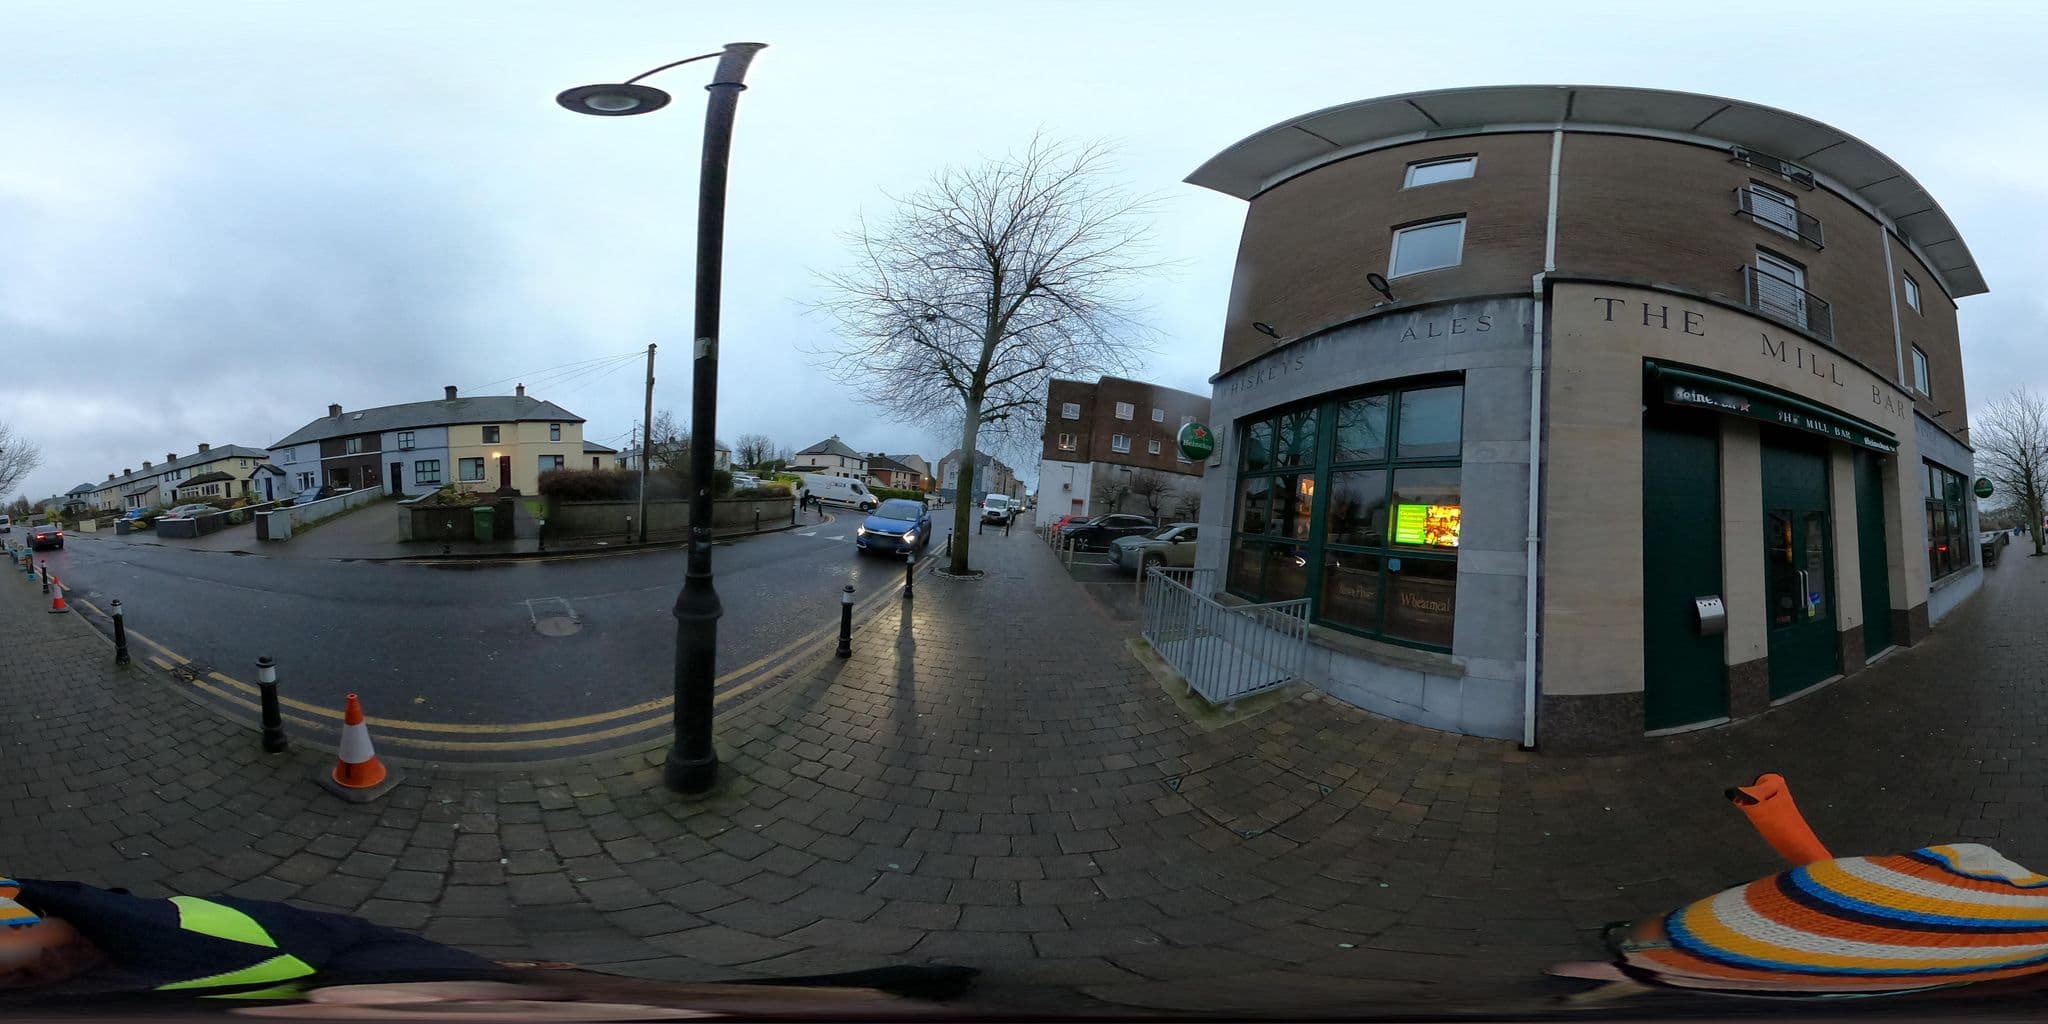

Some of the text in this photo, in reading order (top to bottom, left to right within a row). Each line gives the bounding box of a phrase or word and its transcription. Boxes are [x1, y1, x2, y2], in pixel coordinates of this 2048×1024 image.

[1399, 315, 1492, 343] ALES
[1593, 297, 1906, 419] THE MILL BAR
[1805, 418, 1829, 434] MILL
[1834, 426, 1852, 440] BAR
